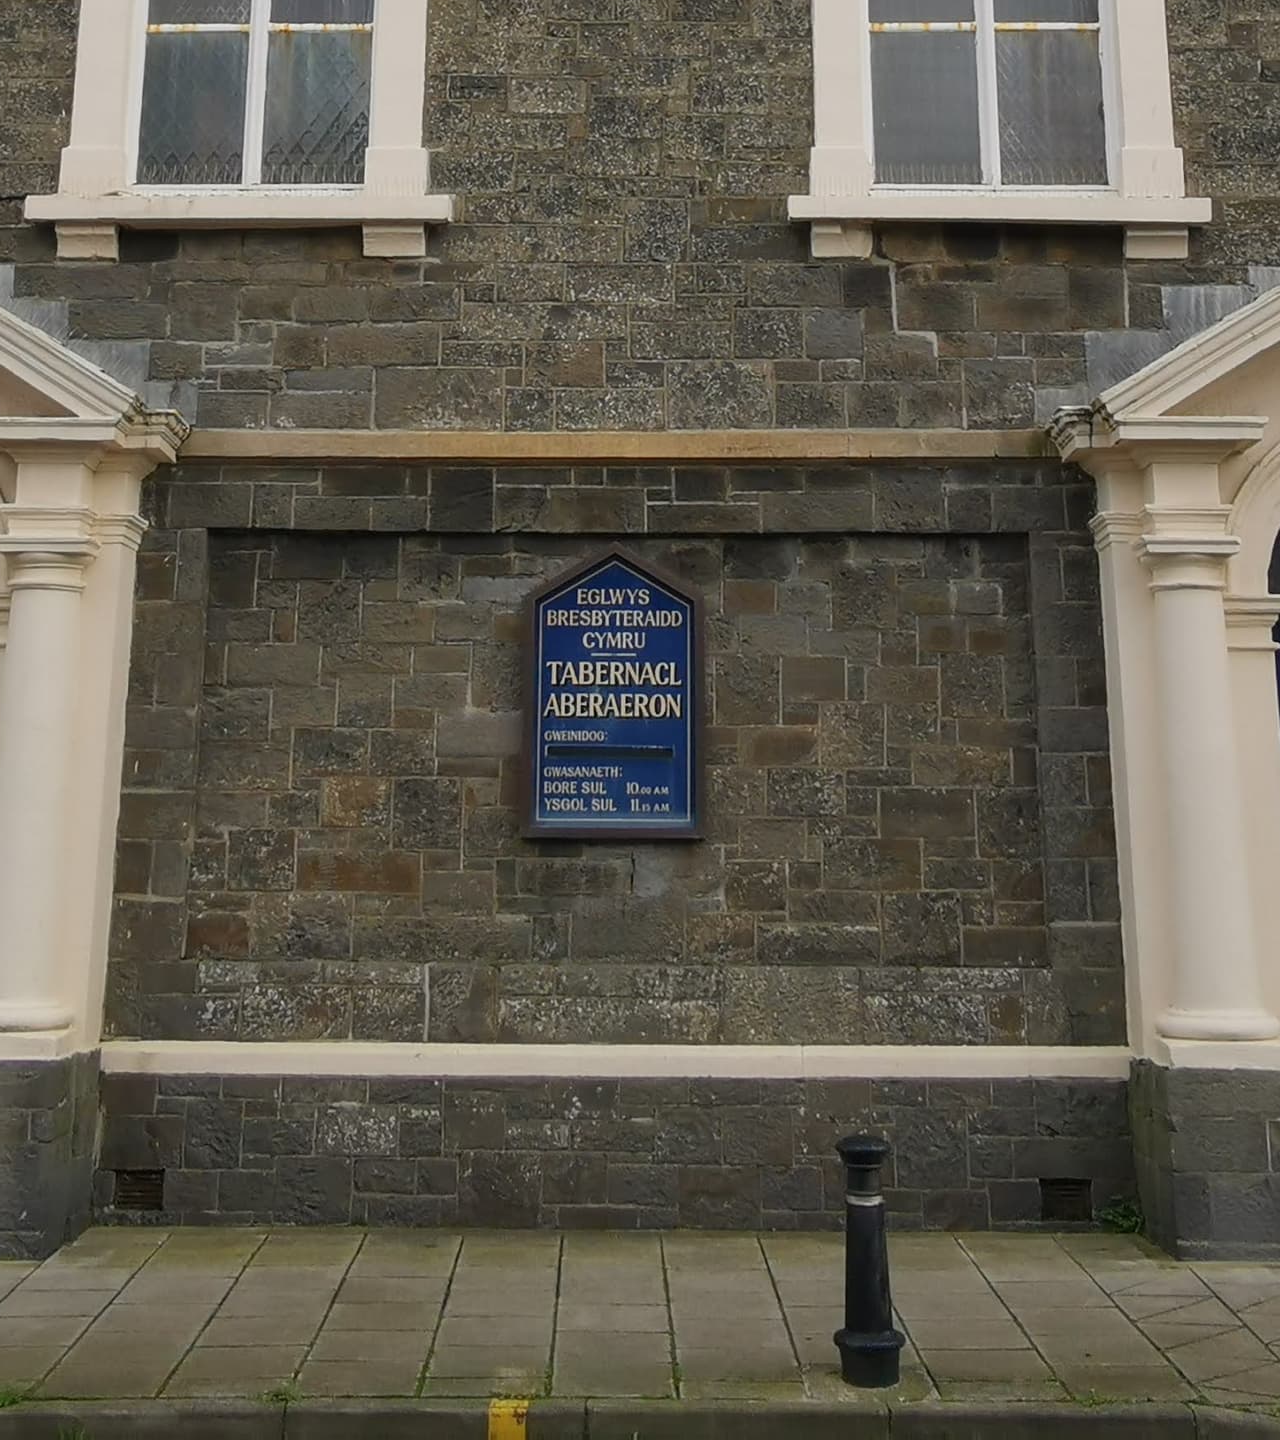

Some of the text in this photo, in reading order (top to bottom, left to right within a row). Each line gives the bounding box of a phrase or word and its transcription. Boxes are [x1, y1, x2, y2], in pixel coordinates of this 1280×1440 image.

[577, 588, 650, 605] EGLWYS
[546, 610, 682, 627] BRESBYTERAIDD
[582, 633, 645, 649] CYMRU
[546, 661, 682, 686] TABERNACL
[543, 694, 682, 718] ABERAERON
[544, 730, 608, 742] GWEINIDOG:
[543, 766, 623, 778] GWASANAETH:
[543, 782, 578, 794] BORE
[582, 782, 607, 794] SUL
[544, 798, 587, 812] YSGOL
[592, 799, 617, 812] SUL
